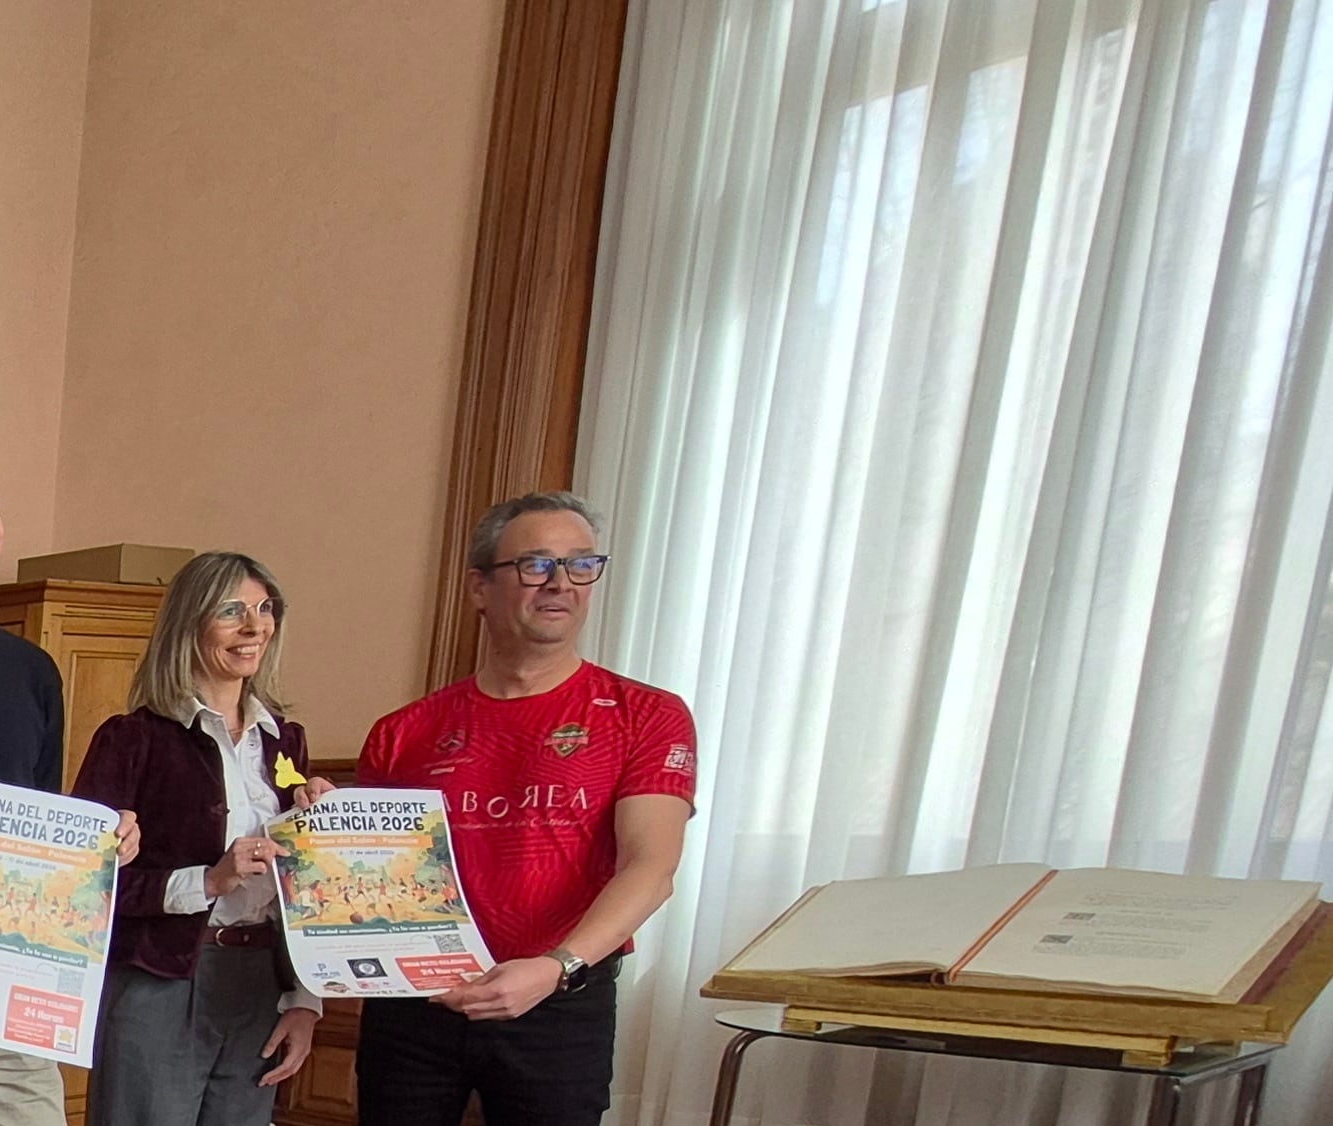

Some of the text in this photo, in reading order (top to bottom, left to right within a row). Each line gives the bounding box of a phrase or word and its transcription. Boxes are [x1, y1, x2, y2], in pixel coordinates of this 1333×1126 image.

[17, 803, 42, 821] DEL
[48, 809, 108, 833] DEPORTE
[285, 801, 428, 822] SEMANA DEL DEPORTE
[295, 816, 424, 833] PALENCIA 2026
[53, 828, 99, 849] 2026
